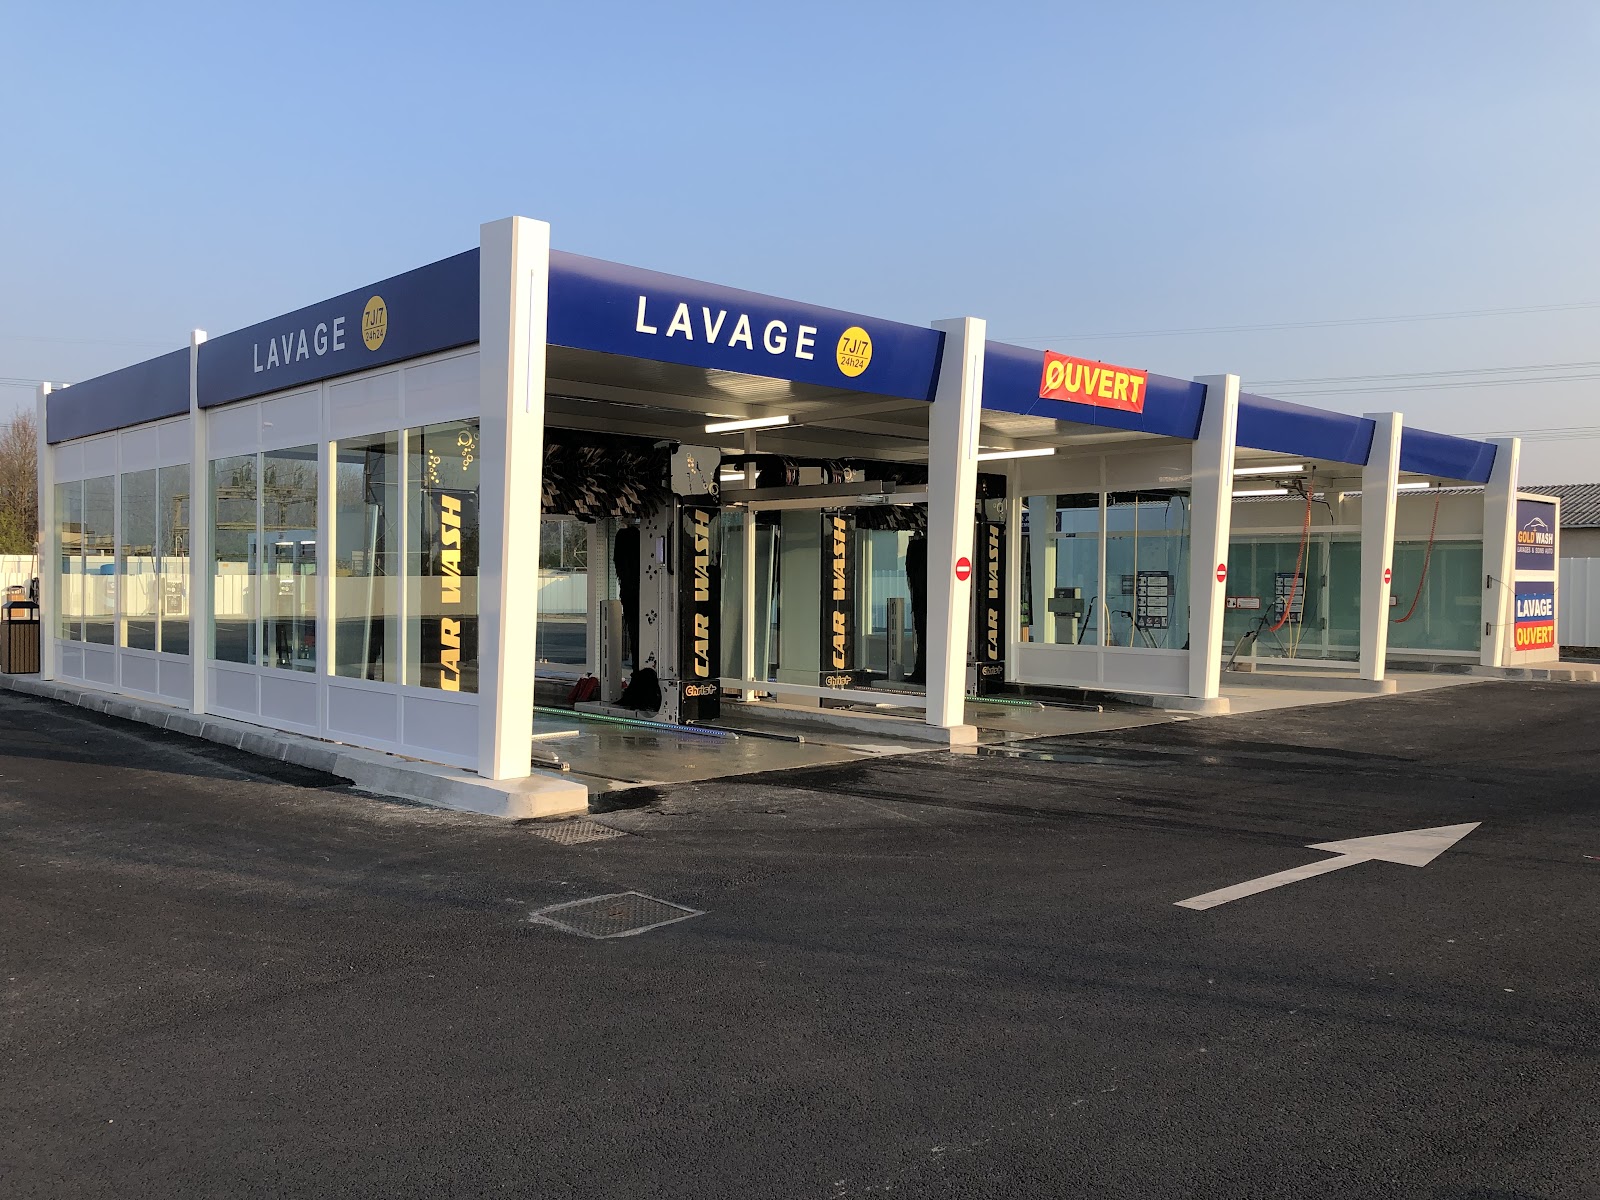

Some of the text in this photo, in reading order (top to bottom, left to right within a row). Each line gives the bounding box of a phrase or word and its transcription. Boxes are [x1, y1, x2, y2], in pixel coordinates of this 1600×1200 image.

[365, 307, 384, 327] 7J/7
[365, 329, 384, 342] 24h24
[636, 295, 818, 361] LAVAGE
[253, 316, 345, 373] LAVAGE
[842, 337, 869, 356] 7J/7
[840, 356, 864, 369] 24h24
[1046, 360, 1145, 403] OUVERT
[1518, 531, 1553, 544] GOLD WASH
[440, 494, 461, 692] CAR WASH
[694, 509, 710, 678] CAR WASH
[832, 516, 846, 670] CAR WASH
[987, 524, 1000, 661] CAR WASH
[1517, 599, 1552, 617] LAVAGE
[1517, 626, 1553, 645] OUVERT
[982, 665, 1003, 676] Christ
[685, 683, 718, 697] Christ
[825, 674, 852, 687] Christ
